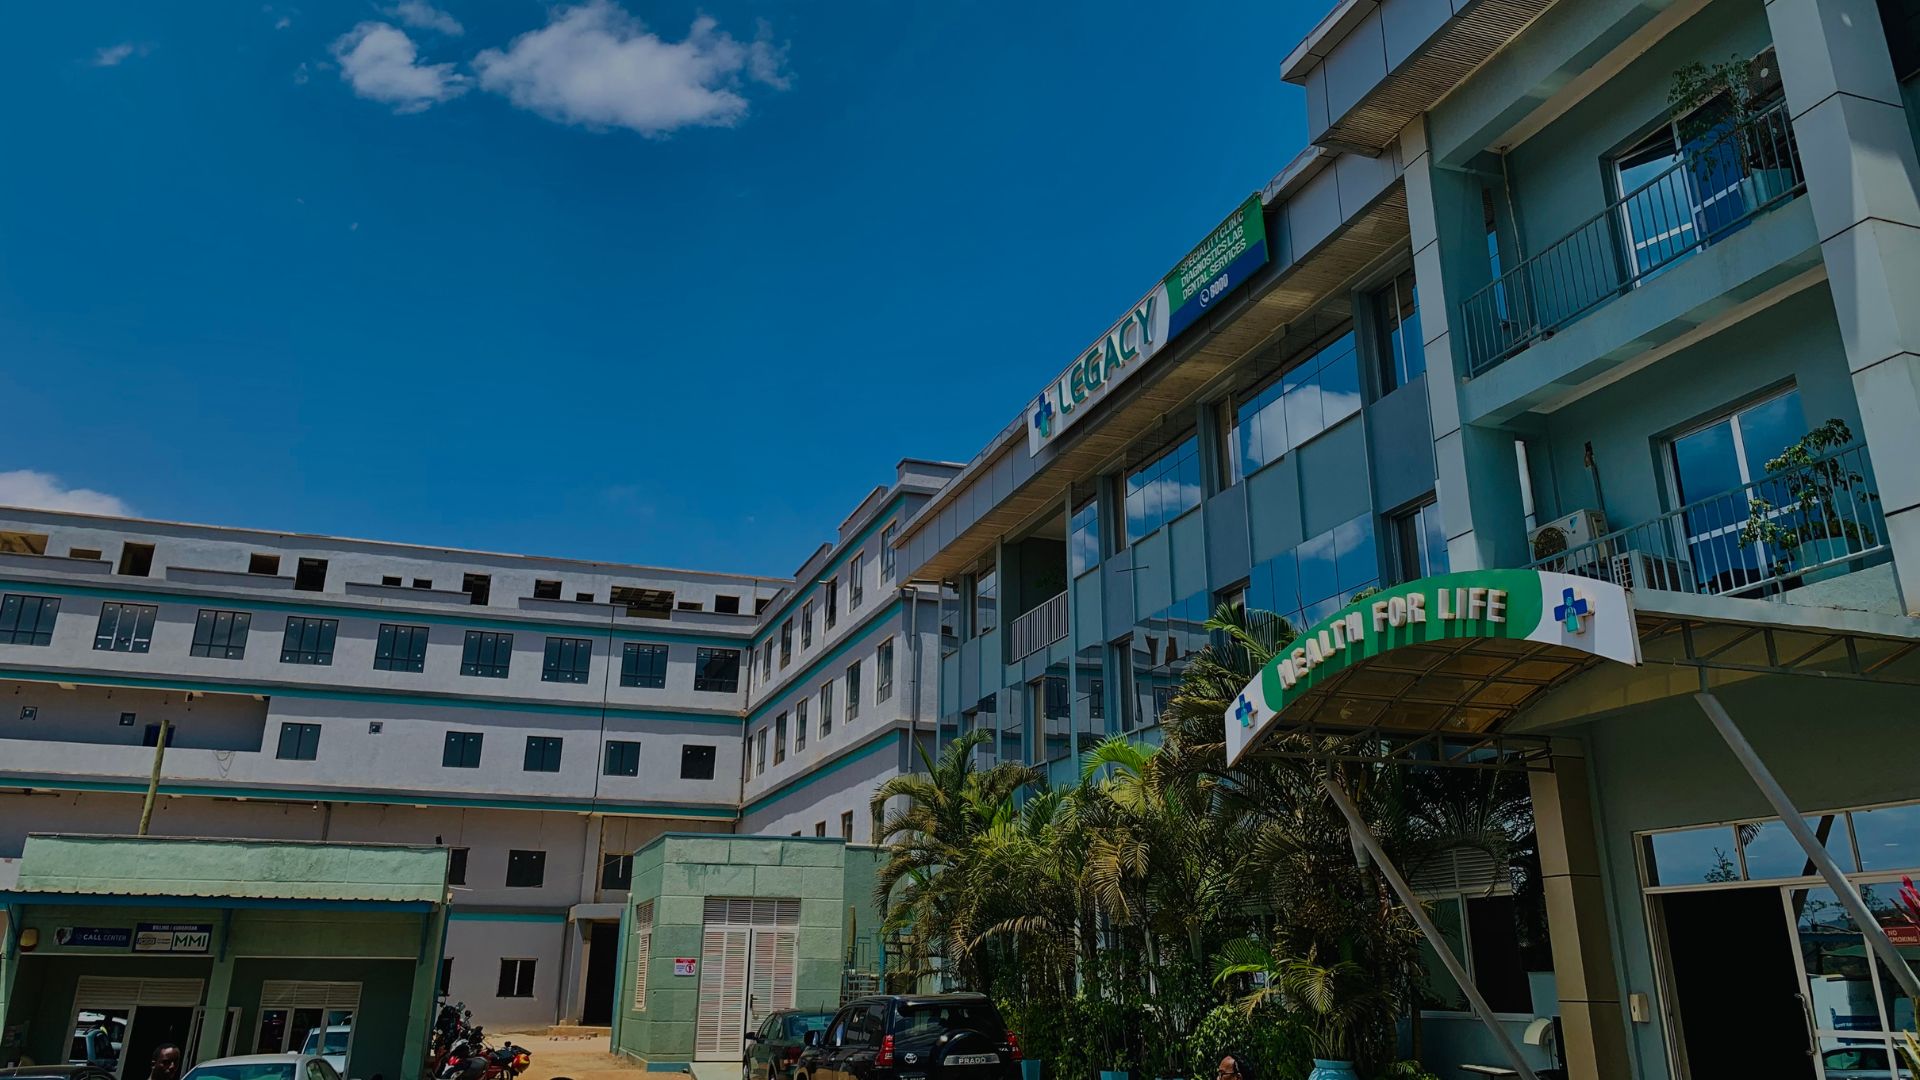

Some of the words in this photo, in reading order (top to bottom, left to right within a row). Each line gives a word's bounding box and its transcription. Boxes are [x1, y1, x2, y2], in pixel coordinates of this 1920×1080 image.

[1219, 210, 1244, 238] CLINIC
[1181, 239, 1227, 287] DIAGNOSTICS
[1226, 225, 1244, 247] LAB
[1182, 271, 1210, 300] DENTAL
[1209, 238, 1247, 275] SERVICES
[1058, 297, 1156, 414] LEGACY
[1276, 611, 1364, 691] HEALTH
[1372, 592, 1426, 632] FOR
[1436, 587, 1508, 624] LIFE
[103, 934, 127, 942] CENTER
[175, 934, 207, 947] MMI
